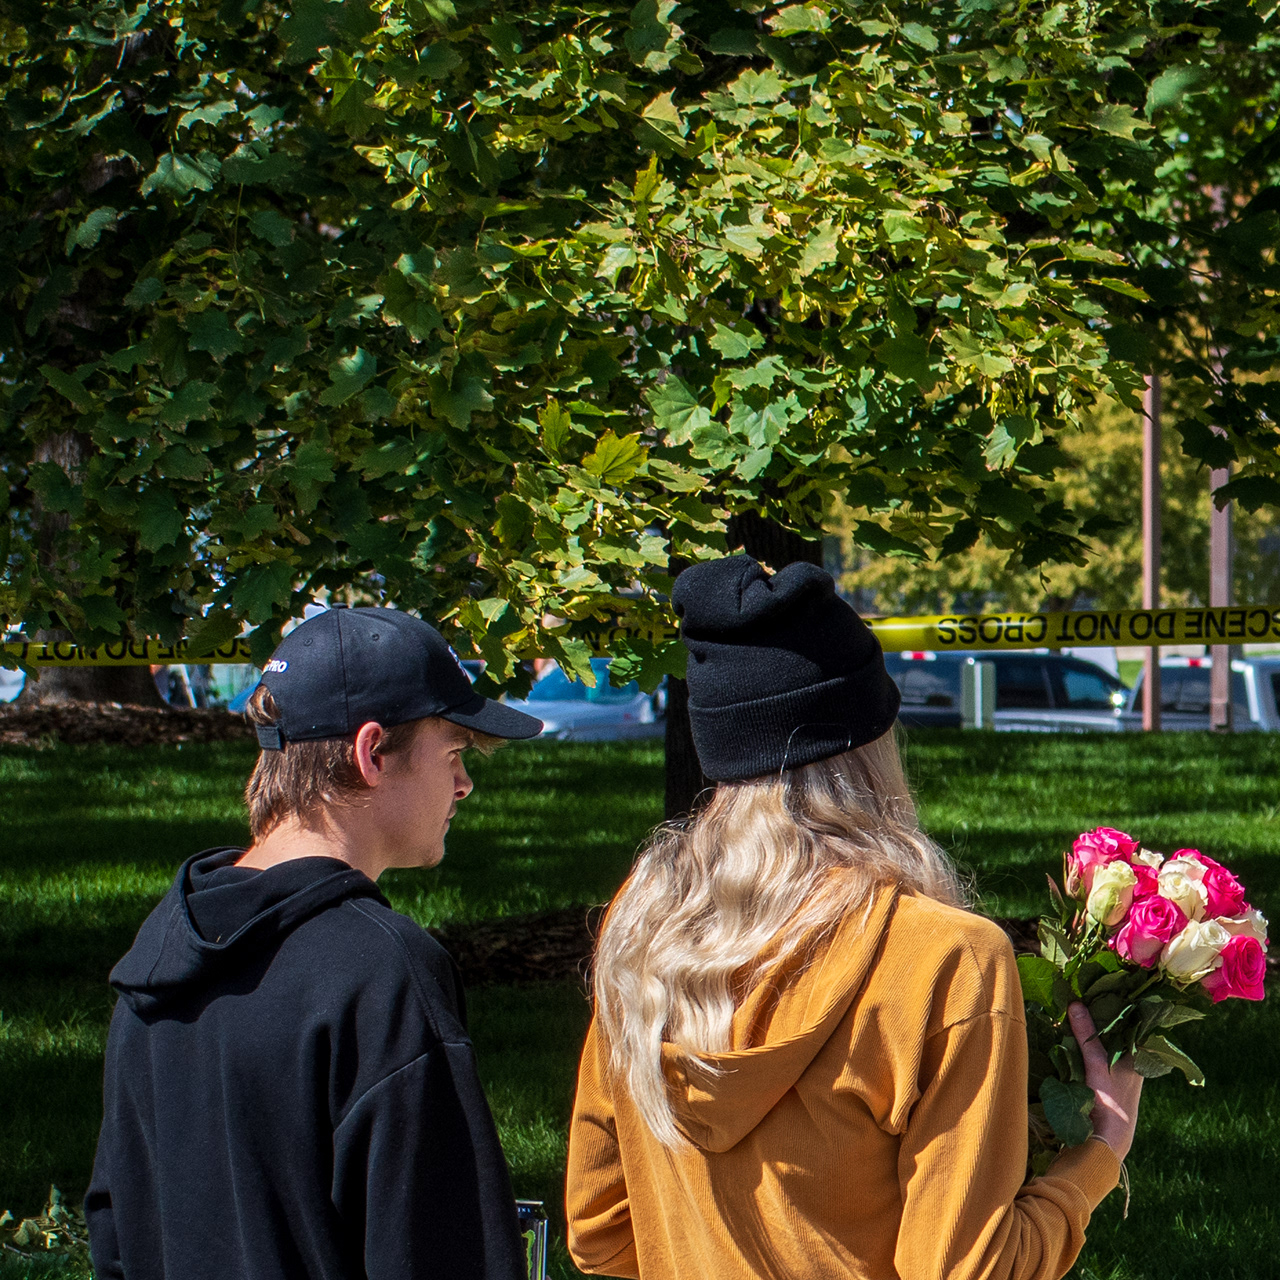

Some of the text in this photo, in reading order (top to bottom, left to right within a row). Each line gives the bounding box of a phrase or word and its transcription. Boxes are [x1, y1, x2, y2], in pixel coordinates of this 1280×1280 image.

[937, 615, 1049, 645] CROSS
[1055, 612, 1122, 642] NOT
[1128, 610, 1176, 640] DO
